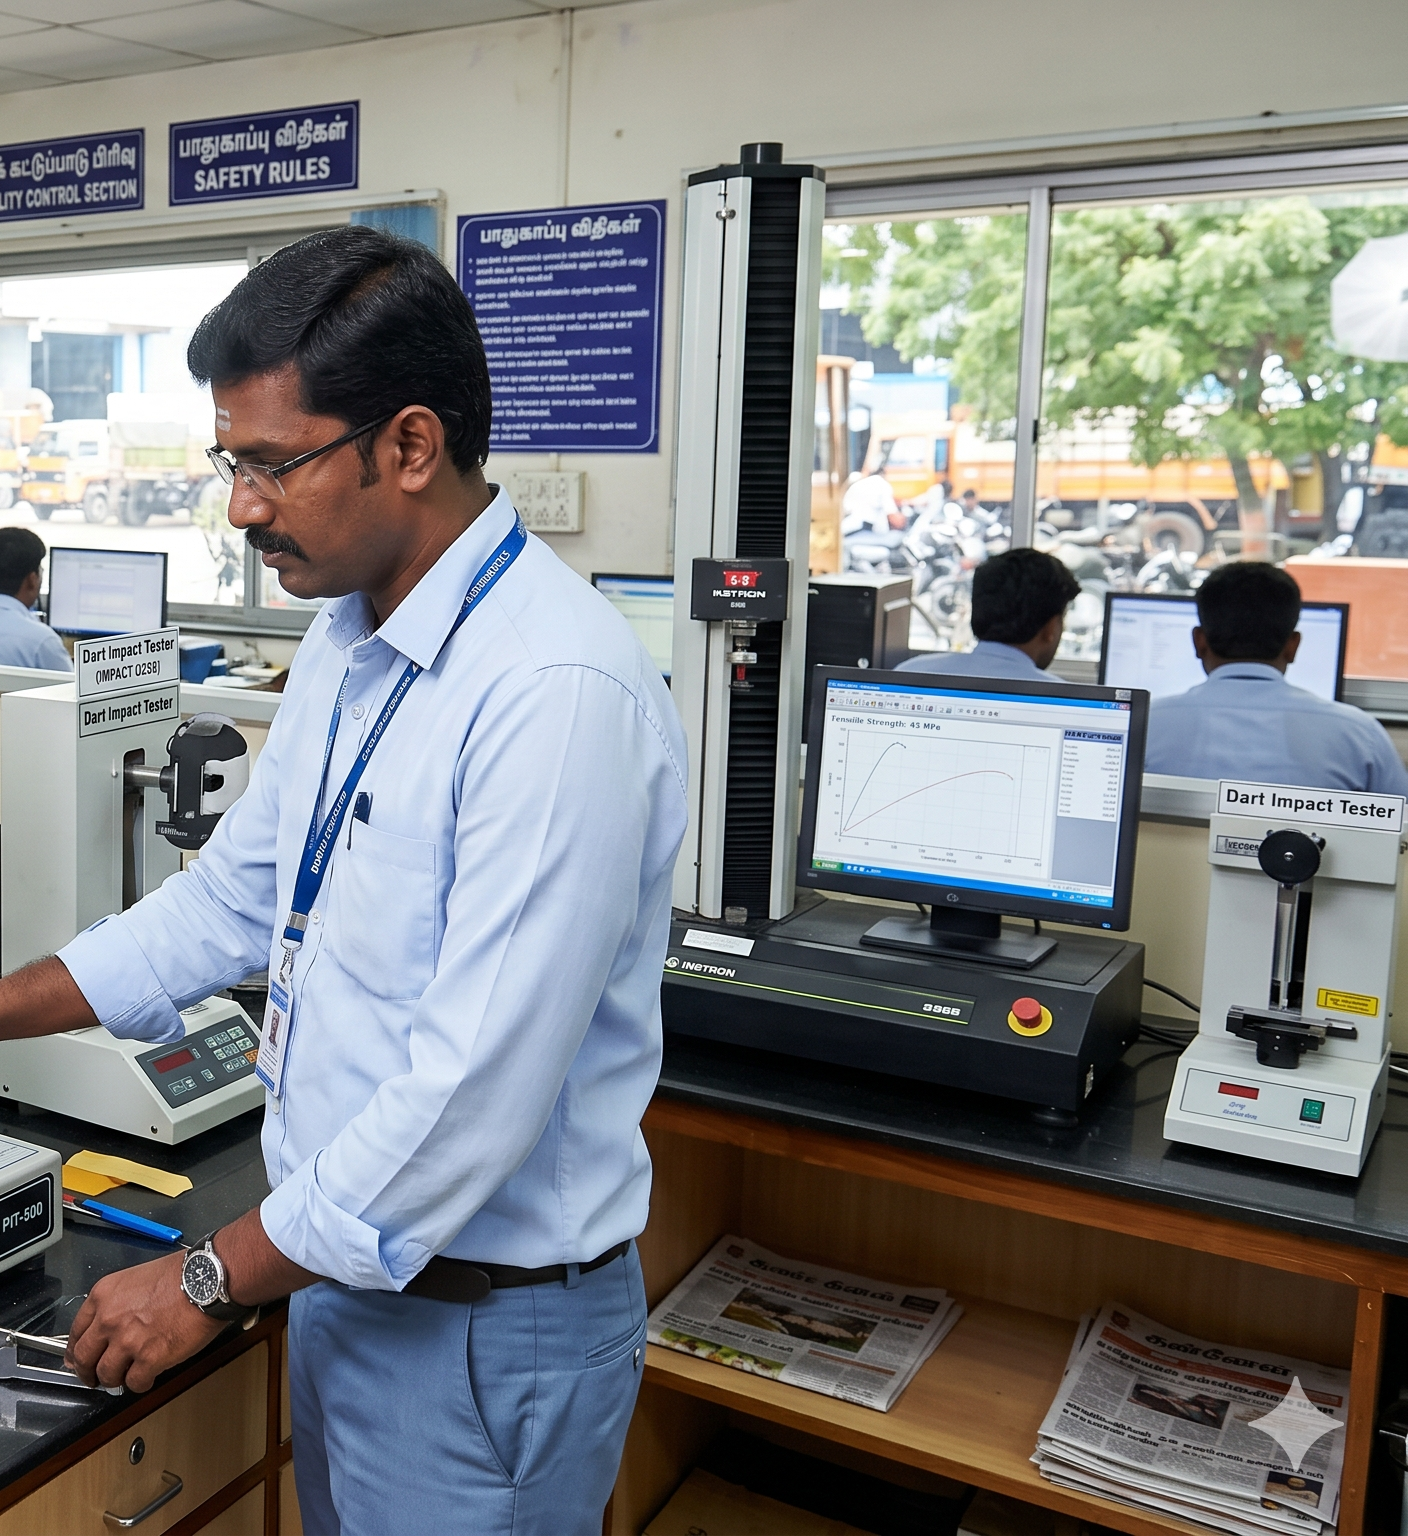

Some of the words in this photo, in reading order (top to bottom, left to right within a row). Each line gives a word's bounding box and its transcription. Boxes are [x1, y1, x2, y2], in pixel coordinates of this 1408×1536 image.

[179, 124, 270, 164] பாதுகாப்பு
[275, 114, 348, 151] விதிகள்
[92, 142, 136, 170] பிரிவு
[194, 163, 264, 192] SAFETY
[269, 156, 330, 184] RULES
[26, 184, 82, 208] CONTROL
[84, 178, 137, 203] SECTION
[480, 219, 567, 248] பாதுகாப்பு
[571, 213, 641, 241] விதிகள்
[83, 647, 106, 664] Dart
[109, 642, 142, 661] Impact
[144, 638, 174, 654] Tester
[84, 708, 106, 726] Dart
[108, 701, 141, 722] Impact
[144, 697, 173, 714] Tester
[1226, 789, 1265, 805] Dart
[1272, 794, 1333, 812] Impact
[1340, 800, 1395, 818] Tester
[3, 1202, 43, 1232] PIT-500
